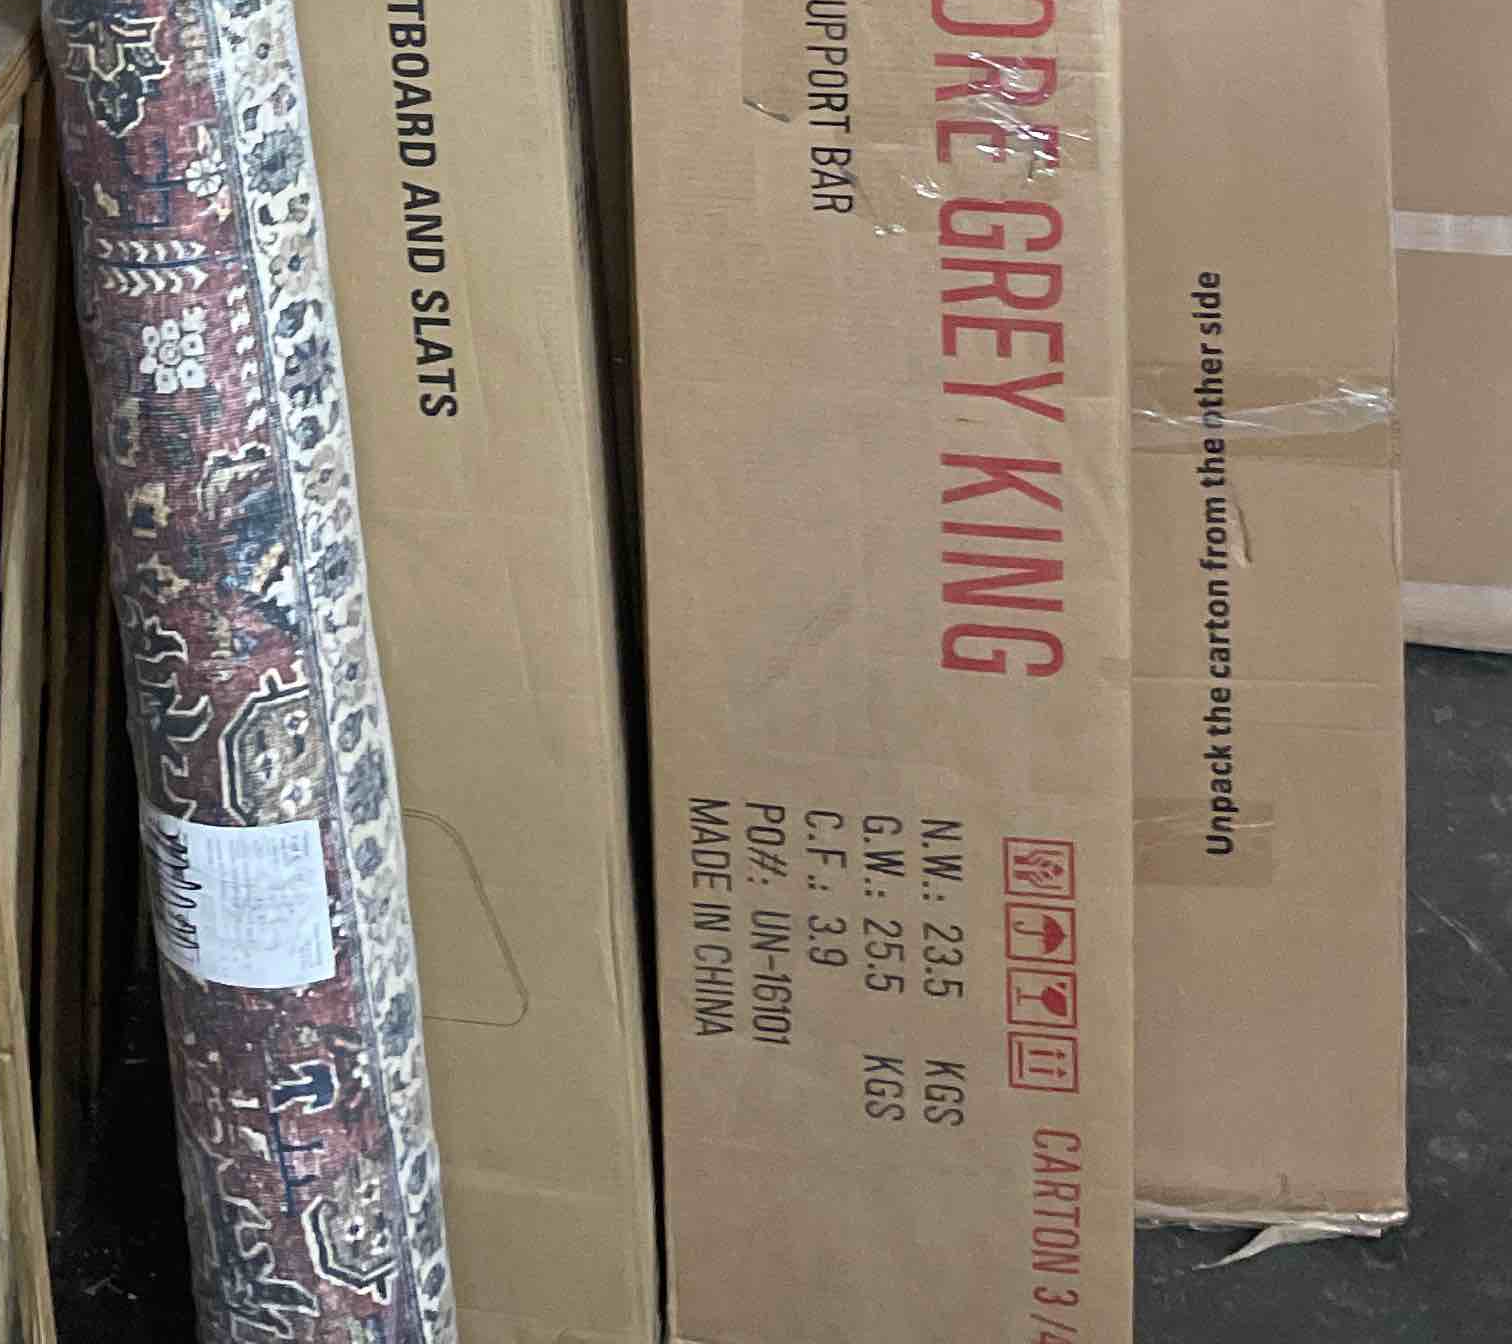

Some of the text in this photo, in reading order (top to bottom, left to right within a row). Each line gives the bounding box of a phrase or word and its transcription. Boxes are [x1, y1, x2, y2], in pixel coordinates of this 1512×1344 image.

[810, 146, 854, 214] BAR
[401, 183, 445, 273] AND
[411, 289, 458, 418] SLATS
[938, 198, 1064, 422] GREY
[940, 452, 1064, 677] KING
[1191, 271, 1239, 855] Unpack the carton from the other side
[689, 797, 734, 1037] MADE IN CHINA
[808, 914, 849, 967] 3.9
[863, 918, 904, 994] 25.5
[922, 921, 964, 999] 23.5
[863, 1054, 905, 1121] KGS
[923, 1059, 966, 1127] KGS
[1032, 1128, 1082, 1274] CARTON
